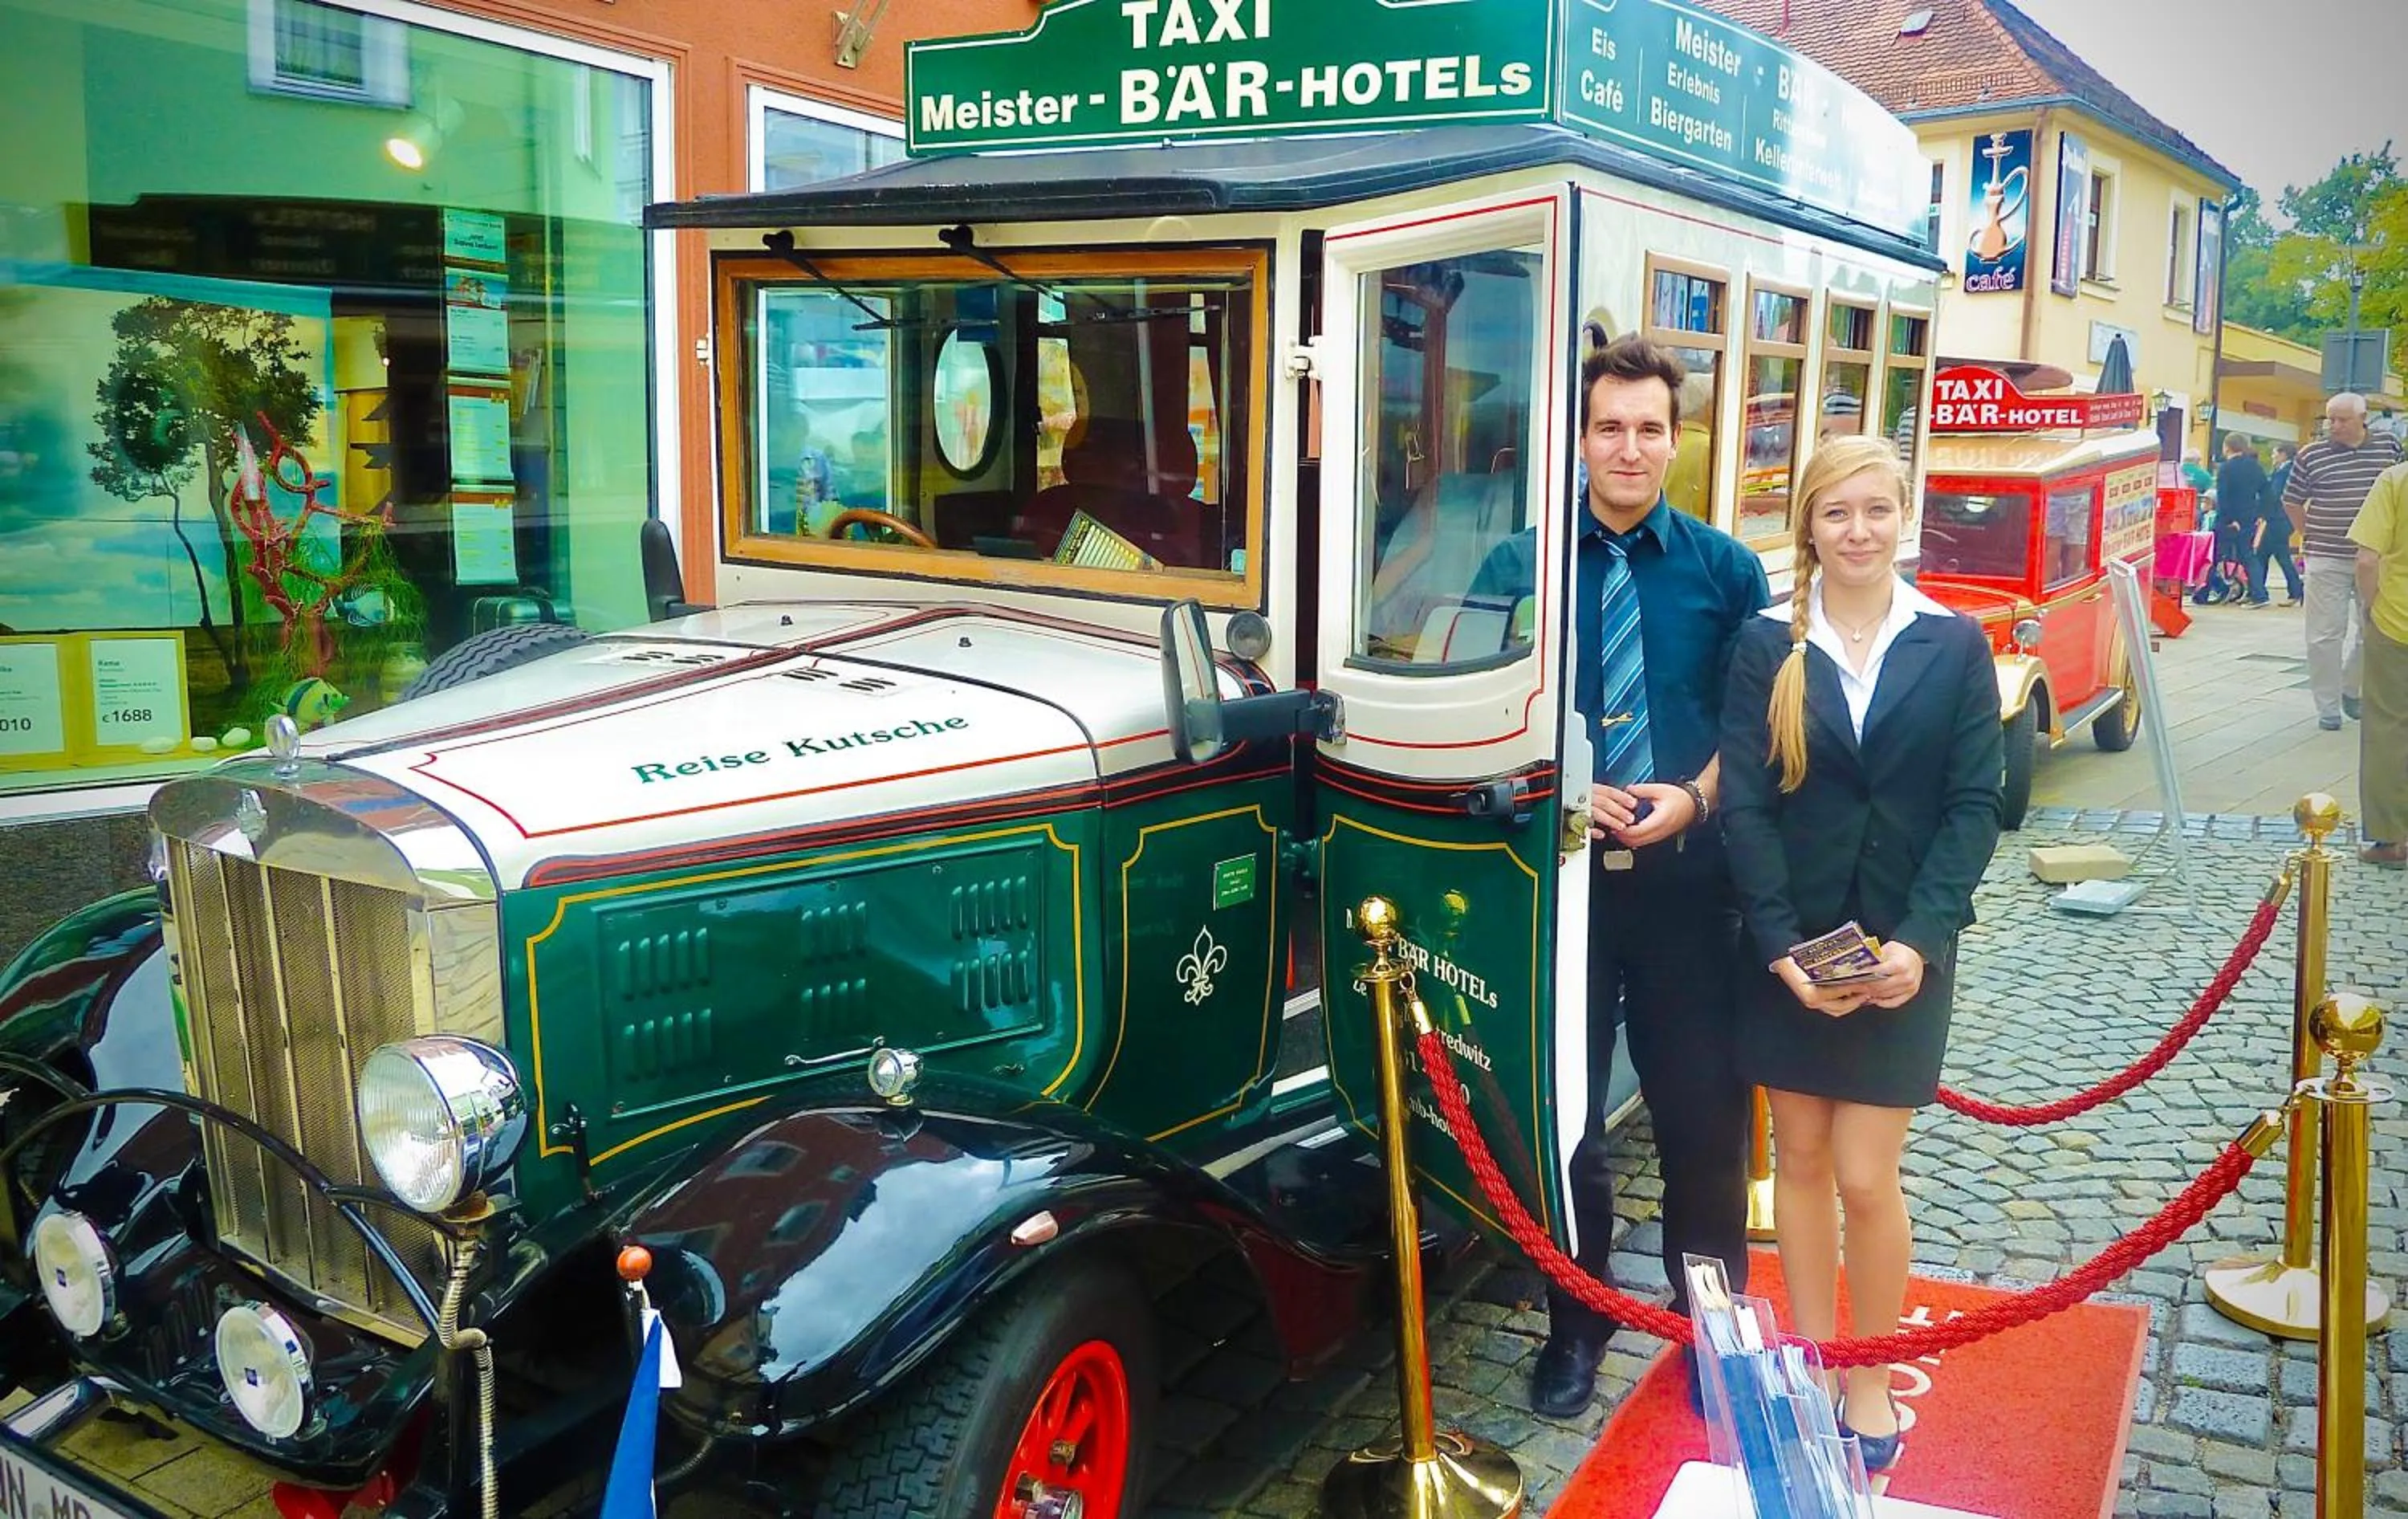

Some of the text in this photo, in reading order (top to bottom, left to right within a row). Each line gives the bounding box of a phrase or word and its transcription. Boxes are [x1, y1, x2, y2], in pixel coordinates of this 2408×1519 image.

[1121, 0, 1271, 49] TAXI
[1592, 26, 1617, 60] Eis
[1675, 17, 1742, 76] Meister
[1580, 69, 1624, 112] Café
[1667, 61, 1721, 104] Erlebnis
[921, 90, 1079, 132] Meister
[1650, 96, 1732, 153] Biergarten
[1935, 378, 2003, 401] TAXI
[630, 716, 970, 784] Reise Kutsche
[1398, 937, 1498, 1009] BÄR HOTELs
